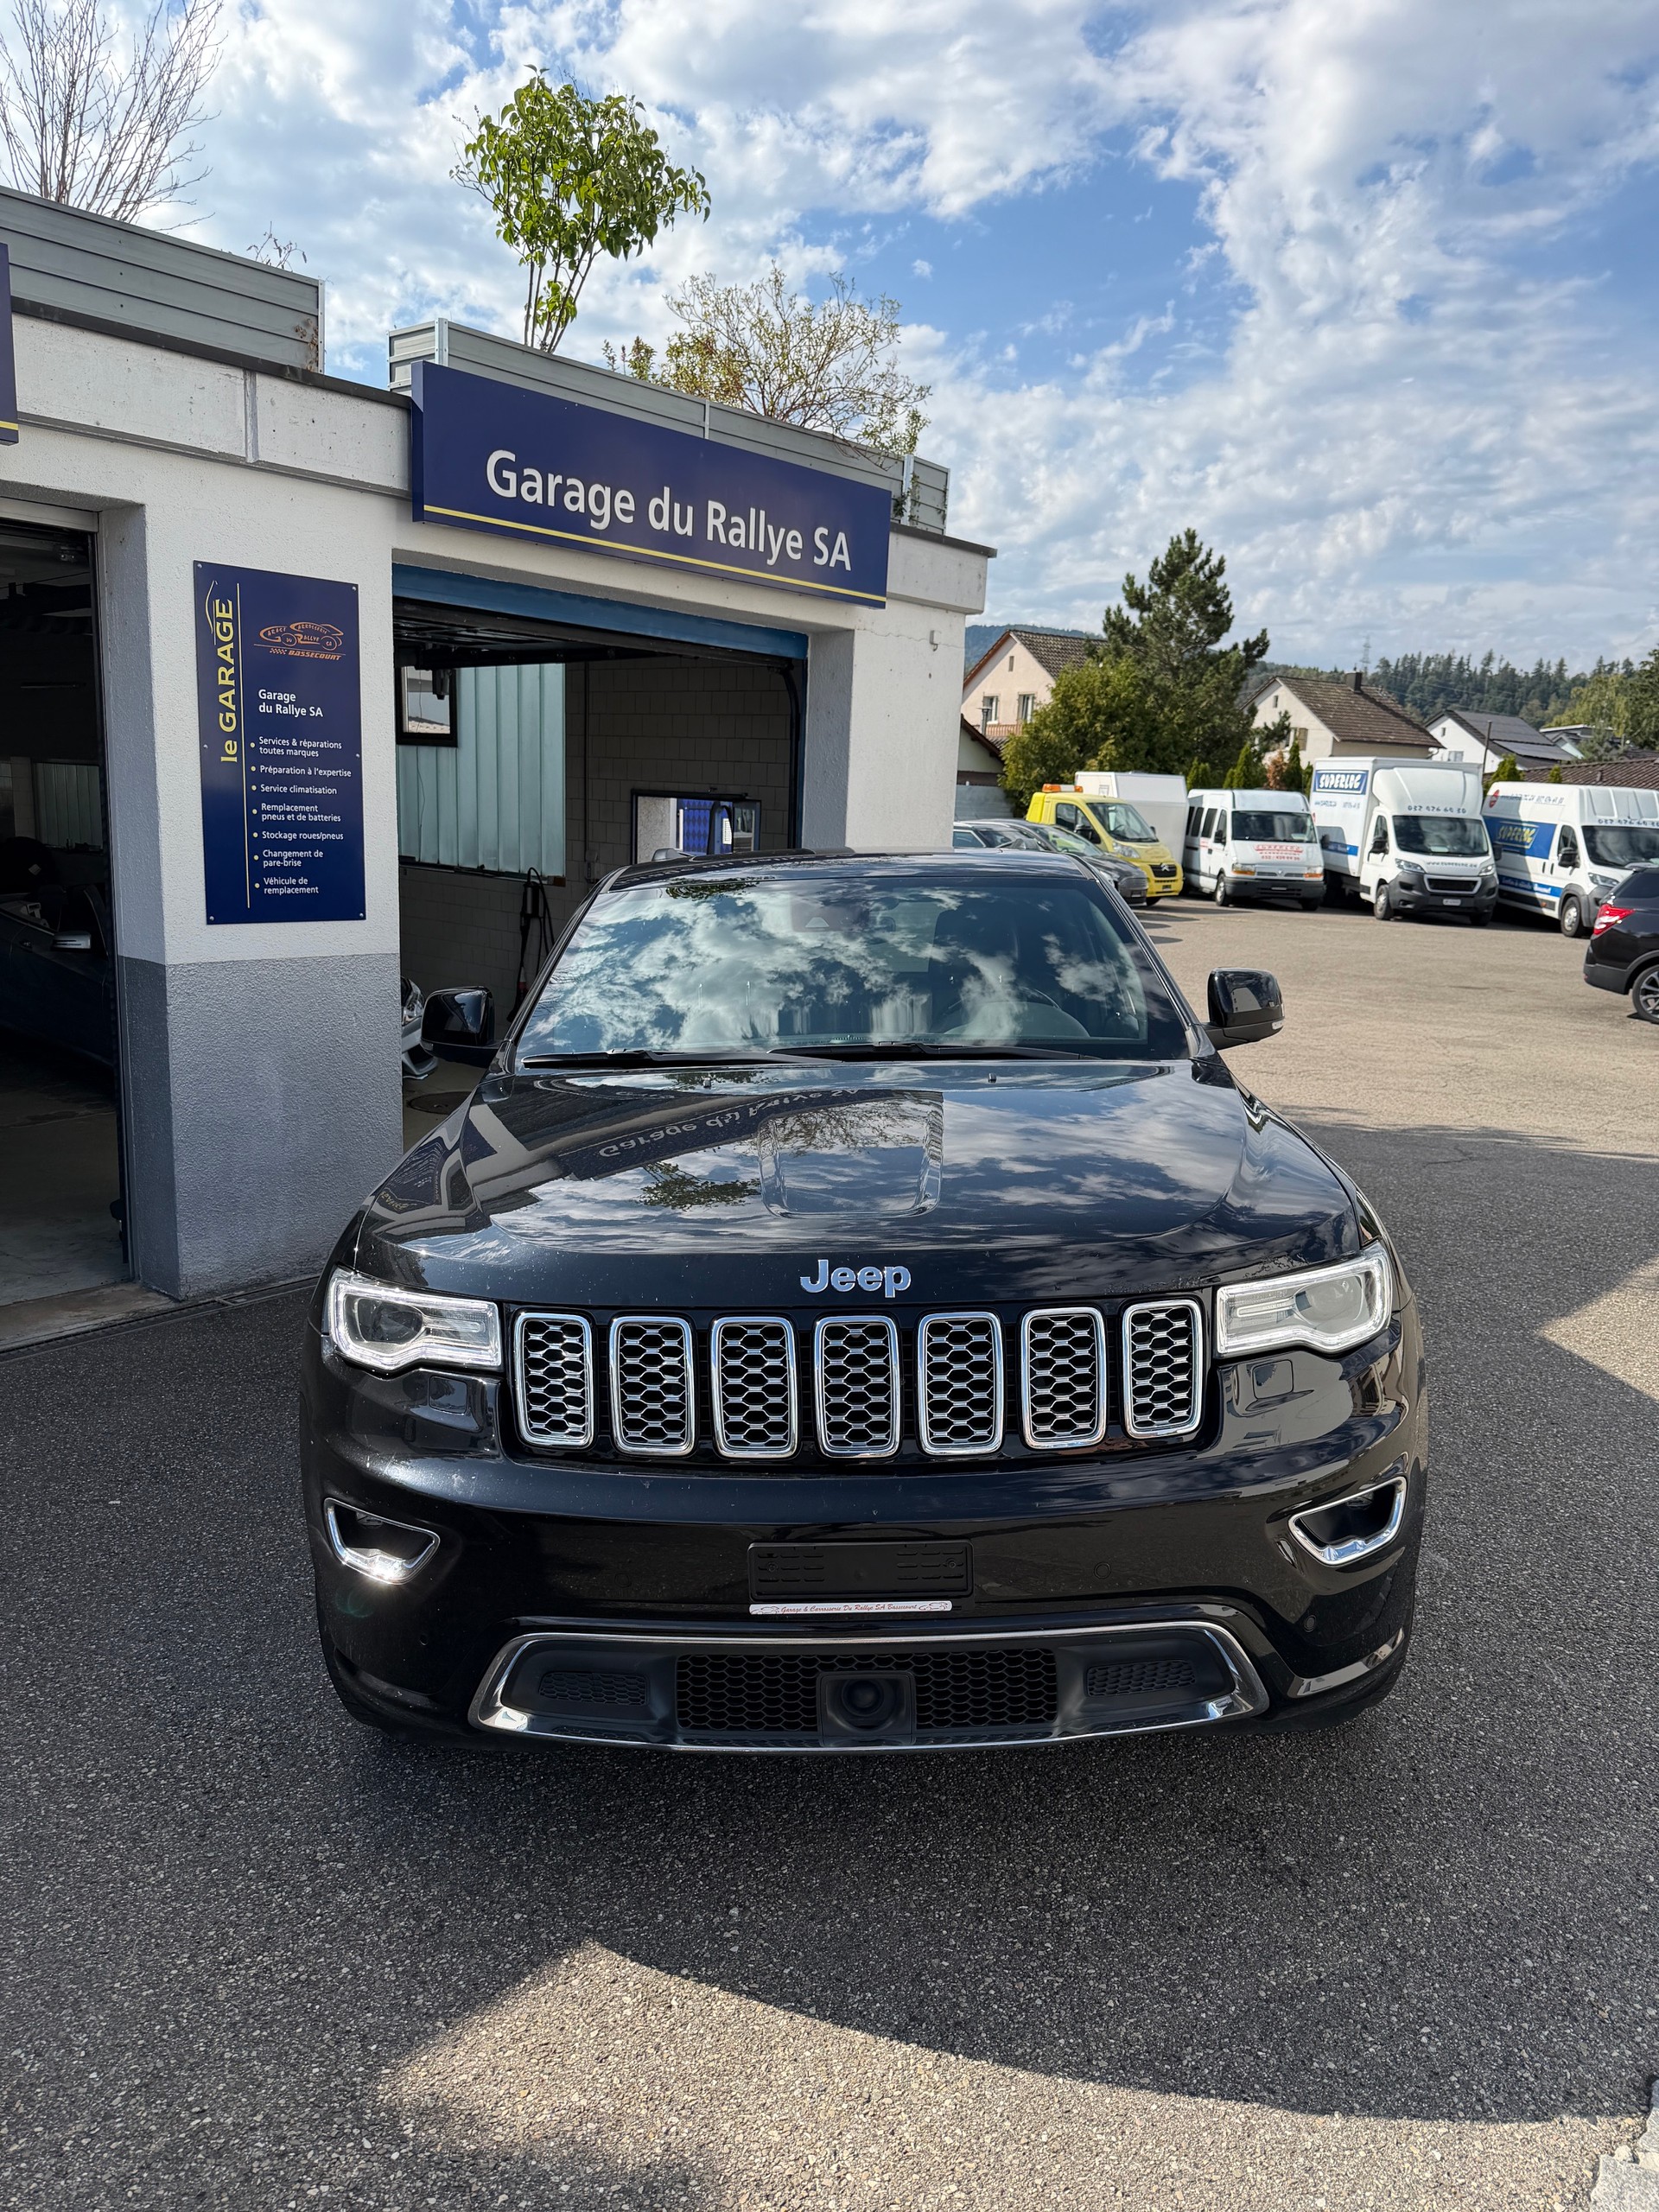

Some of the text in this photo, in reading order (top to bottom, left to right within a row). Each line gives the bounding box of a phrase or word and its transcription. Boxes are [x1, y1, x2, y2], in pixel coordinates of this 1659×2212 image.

[486, 449, 852, 571] Garage du Rallye SA
[288, 650, 342, 661] BASSECOURT
[215, 598, 238, 763] le GARAGE
[258, 689, 296, 703] Garage
[258, 702, 323, 717] du Rallye SA
[259, 736, 342, 749] Services & réparations
[259, 747, 319, 758] toutes marques
[260, 765, 352, 778] Préparation à l'expertise
[260, 784, 337, 795] Service climatisation
[261, 803, 319, 813] Remplacement
[262, 814, 285, 823] pneus
[308, 813, 341, 822] batteries
[262, 830, 344, 842] Stockage roues/pneus
[263, 849, 312, 859] Changement
[263, 858, 302, 868] pare-brise
[264, 876, 308, 886] Véhicule de
[264, 886, 320, 896] remplacement
[800, 1259, 912, 1298] Jeep
[781, 1605, 802, 1615] Garage
